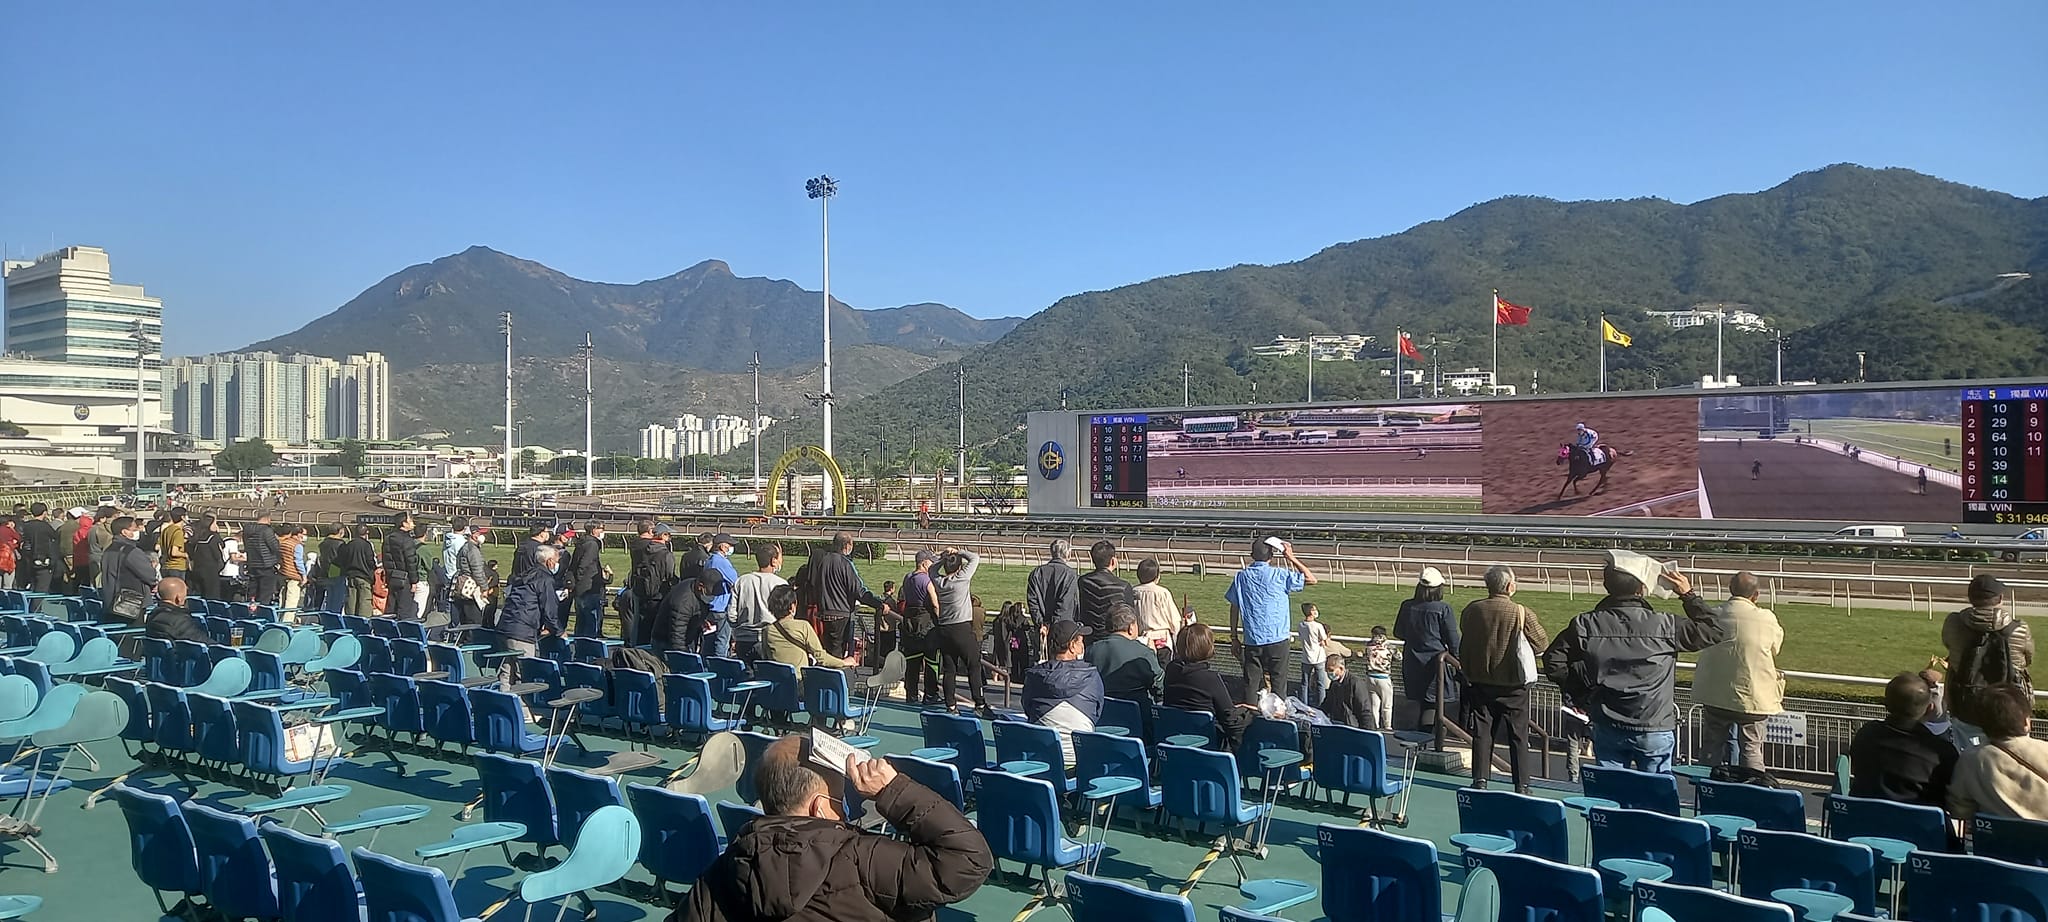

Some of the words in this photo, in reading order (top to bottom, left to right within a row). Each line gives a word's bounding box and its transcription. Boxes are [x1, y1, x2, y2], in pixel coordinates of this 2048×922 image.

[1988, 390, 1996, 400] 5
[1968, 405, 1974, 413] 1
[1992, 404, 2007, 413] 10
[2030, 404, 2038, 412] 8
[1968, 419, 1975, 428] 2
[1992, 418, 2007, 428] 29
[2030, 418, 2038, 427] 9
[1968, 433, 1975, 442] 3
[1992, 432, 2007, 442] 64
[2027, 432, 2042, 441] 10
[1968, 447, 1975, 456] 4
[1992, 447, 2007, 456] 10
[2027, 446, 2042, 455] 11
[1968, 461, 1975, 470] 5
[1992, 461, 2007, 470] 39
[1968, 475, 1975, 484] 6
[1992, 475, 2007, 484] 14
[1968, 489, 1975, 498] 7
[1992, 489, 2007, 498] 40
[1995, 513, 2004, 523] $
[1158, 749, 1167, 758] D2
[973, 777, 982, 785] D2
[1701, 786, 1714, 794] D2
[1458, 794, 1471, 804] D2
[1833, 801, 1848, 811] D2
[1592, 813, 1607, 823] D2
[1976, 819, 1992, 829] D2
[1320, 830, 1333, 842] D2
[1742, 835, 1758, 846] D2
[1912, 858, 1931, 869] D2
[1068, 883, 1082, 897] D2
[1638, 887, 1656, 901] D2
